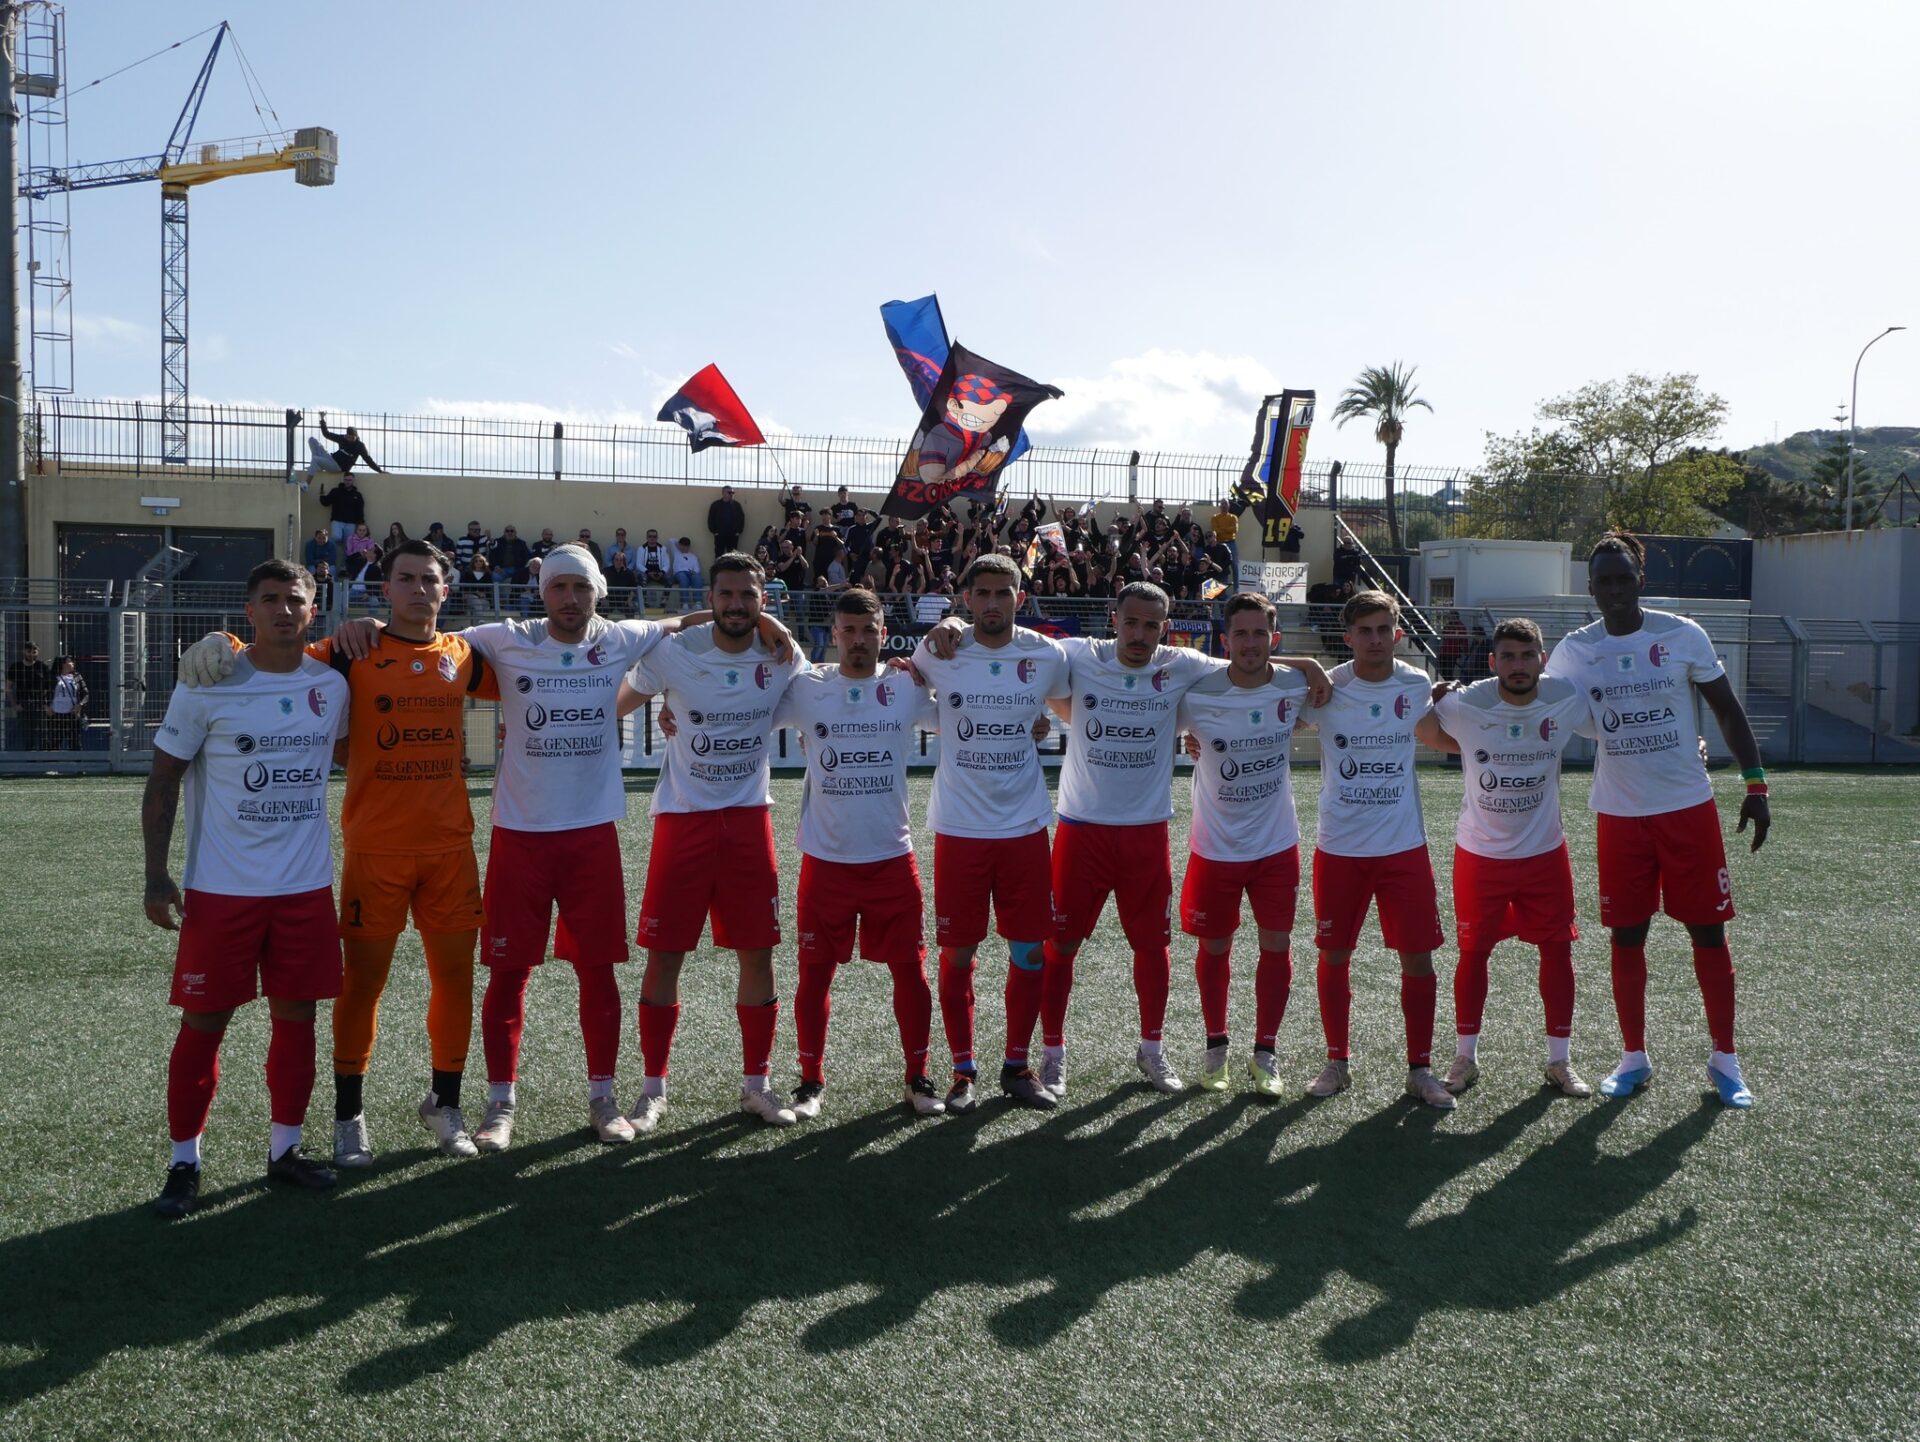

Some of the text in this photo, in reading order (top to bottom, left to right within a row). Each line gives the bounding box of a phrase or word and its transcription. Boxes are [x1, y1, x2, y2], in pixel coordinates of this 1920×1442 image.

[1264, 518, 1292, 542] 19
[1264, 566, 1304, 578] GIORGIO
[1257, 591, 1293, 602] DICA
[536, 675, 614, 688] ermeslink
[1604, 676, 1676, 696] ermeslink
[965, 692, 1037, 706] ermeslink
[1100, 697, 1170, 712] ermeslink
[550, 707, 605, 722] EGEA
[706, 707, 771, 722] ermeslink
[1622, 707, 1675, 724] EGEA
[831, 720, 902, 733] ermeslink
[976, 723, 1026, 736] EGEA
[1105, 725, 1156, 738] EGEA
[259, 731, 330, 748] ermeslink
[402, 728, 455, 741] EGEA
[1230, 729, 1291, 749] ermeslink
[1350, 731, 1412, 745] ermeslink
[1620, 729, 1679, 749] GENERALI
[544, 735, 604, 750] GENERALI
[713, 736, 763, 751] EGEA
[1649, 741, 1680, 753] MODICA
[526, 750, 561, 758] AGENZIA
[574, 748, 602, 757] MODICA
[840, 750, 893, 764] EGEA
[971, 750, 1026, 764] GENERALI
[1103, 748, 1157, 763] GENERALI
[1492, 748, 1557, 762] ermeslink
[395, 758, 453, 774] GENERALI
[956, 761, 987, 771] AGENZIA
[997, 762, 1026, 771] MODICA
[1087, 759, 1119, 769] AGENZIA
[1129, 760, 1156, 769] MODICA
[1241, 753, 1286, 774] EGEA
[1359, 762, 1405, 774] EGEA
[272, 767, 323, 783] EGEA
[415, 773, 423, 781] DI
[690, 771, 723, 782] AGENZIA
[838, 774, 894, 789] GENERALI
[1500, 775, 1546, 788] EGEA
[822, 788, 854, 796] AGENZIA
[865, 787, 893, 795] MODICA
[1493, 791, 1544, 808] GENERALI
[238, 813, 280, 823] AGENZIA
[280, 814, 291, 823] DI
[1716, 867, 1730, 895] 6
[348, 898, 364, 927] 1
